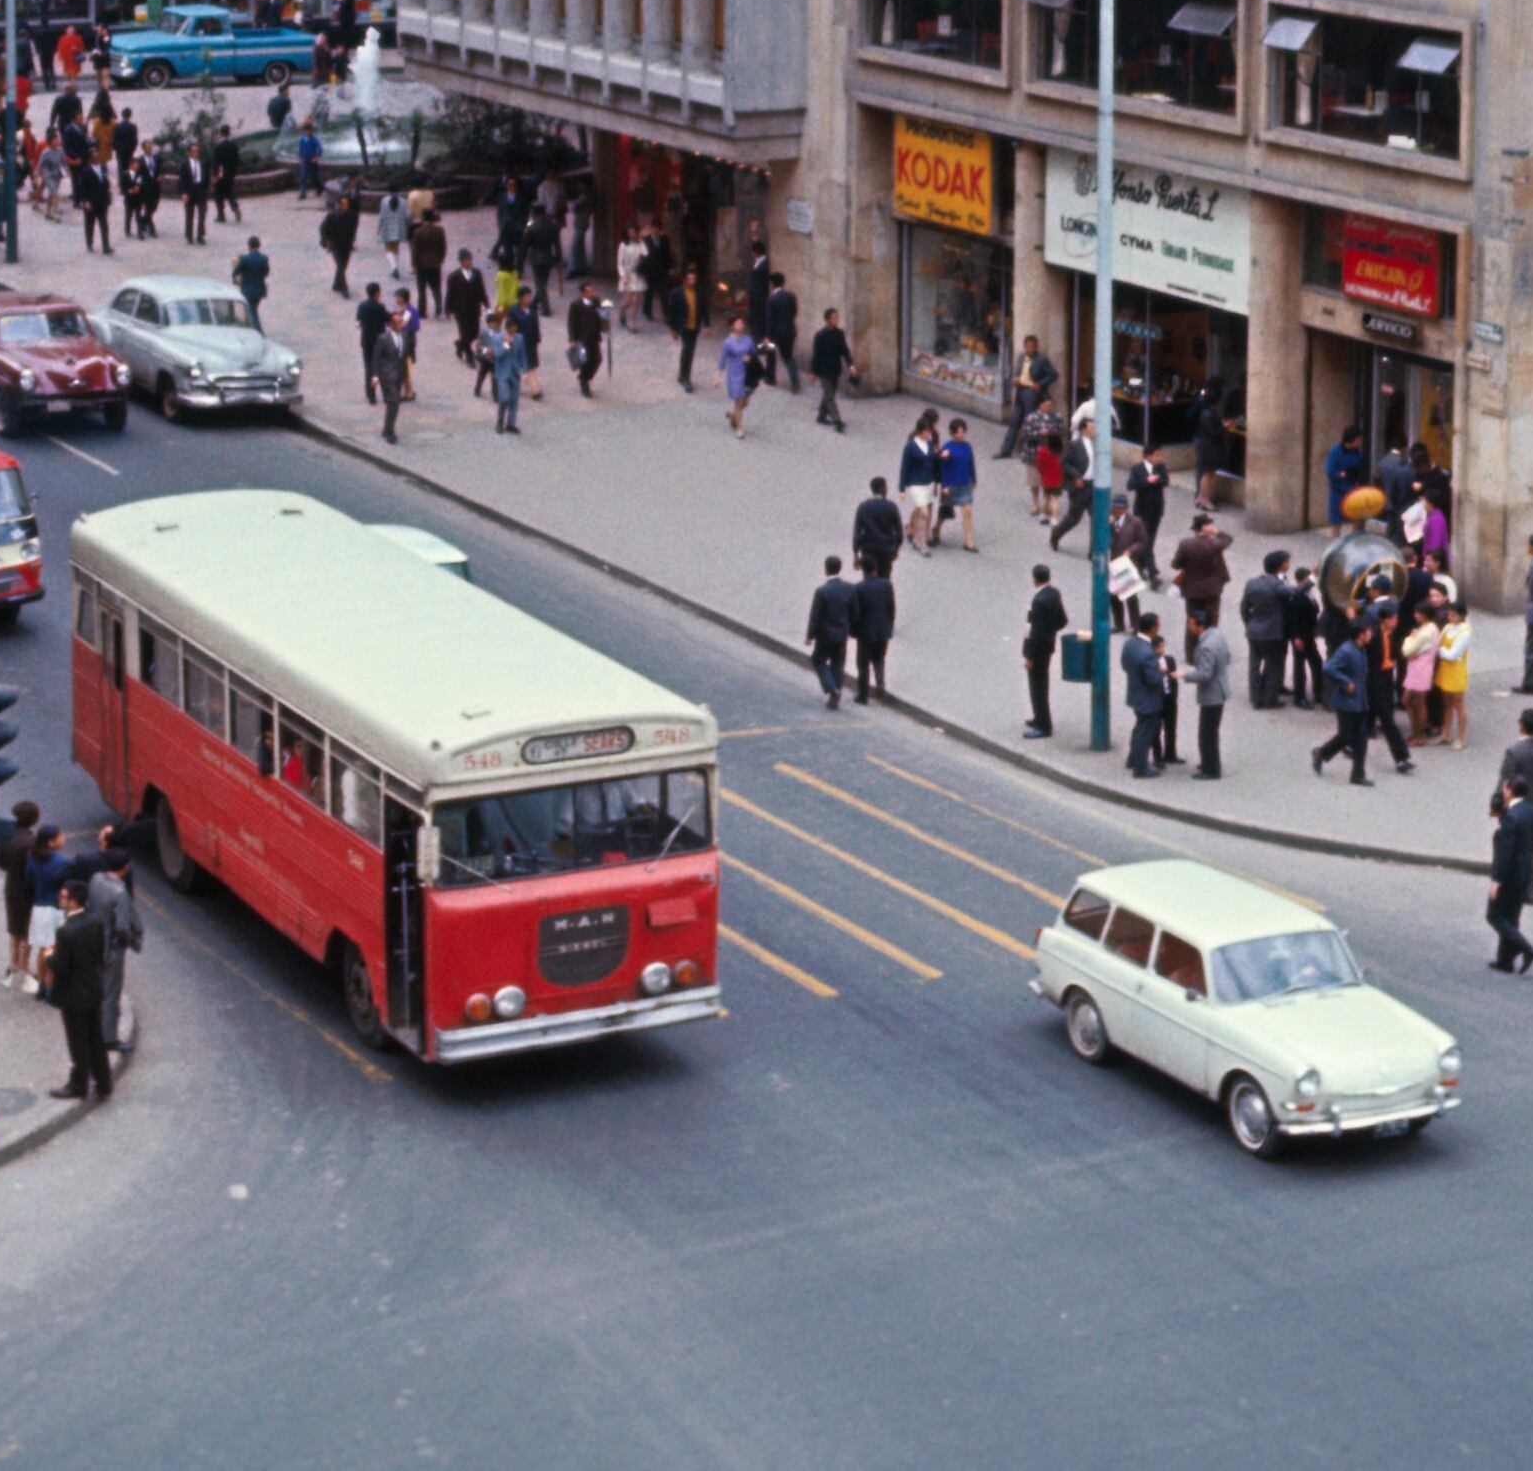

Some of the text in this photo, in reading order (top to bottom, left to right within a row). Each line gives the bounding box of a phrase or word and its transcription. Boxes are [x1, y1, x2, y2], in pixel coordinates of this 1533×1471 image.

[897, 147, 986, 206] KODAK
[1119, 233, 1154, 253] CYMA
[653, 728, 691, 745] 548
[464, 750, 503, 771] 548
